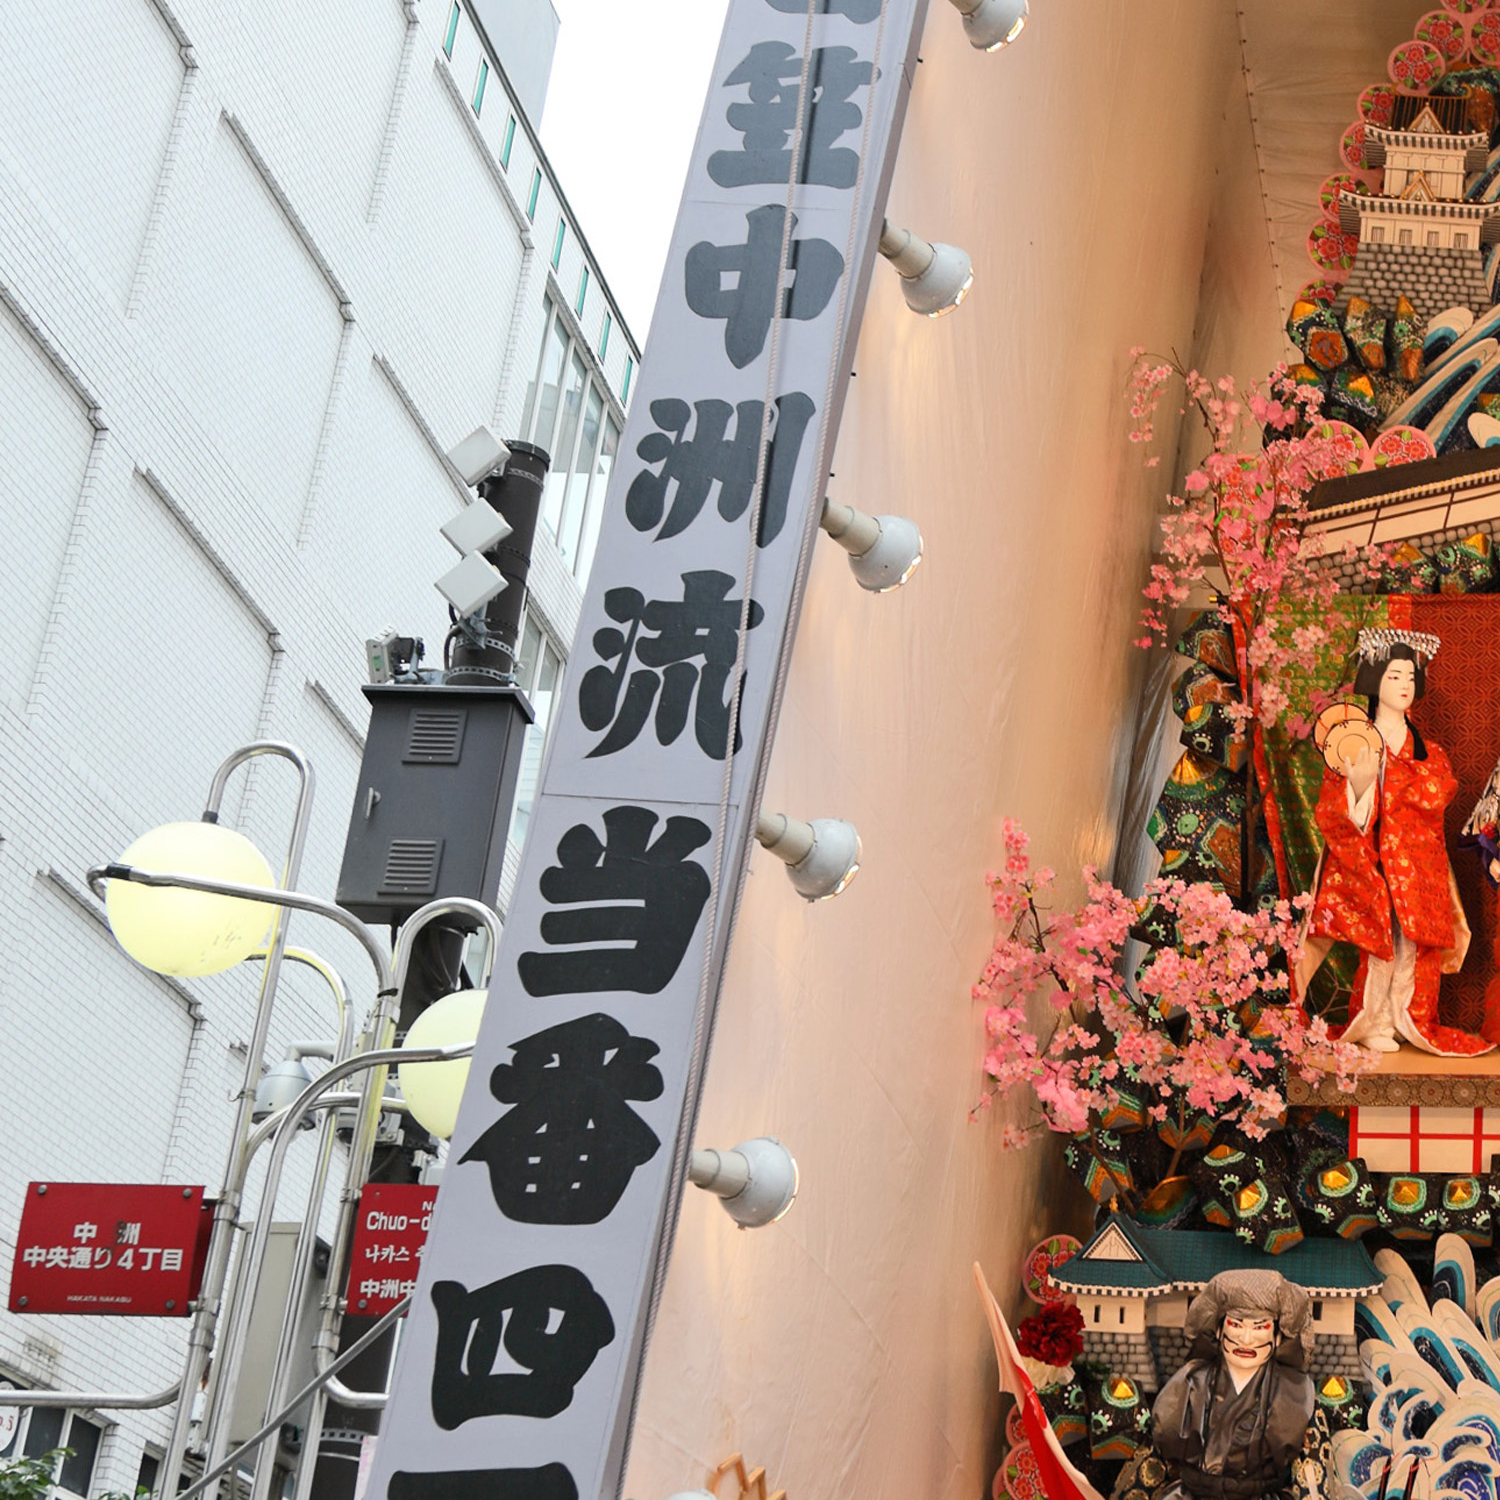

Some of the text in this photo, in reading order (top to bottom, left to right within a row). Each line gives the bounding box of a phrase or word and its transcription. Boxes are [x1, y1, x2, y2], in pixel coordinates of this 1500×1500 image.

[22, 1248, 183, 1271] 中央通り4丁目
[365, 1244, 410, 1264] 나카스
[360, 1278, 416, 1299] 中洲中
